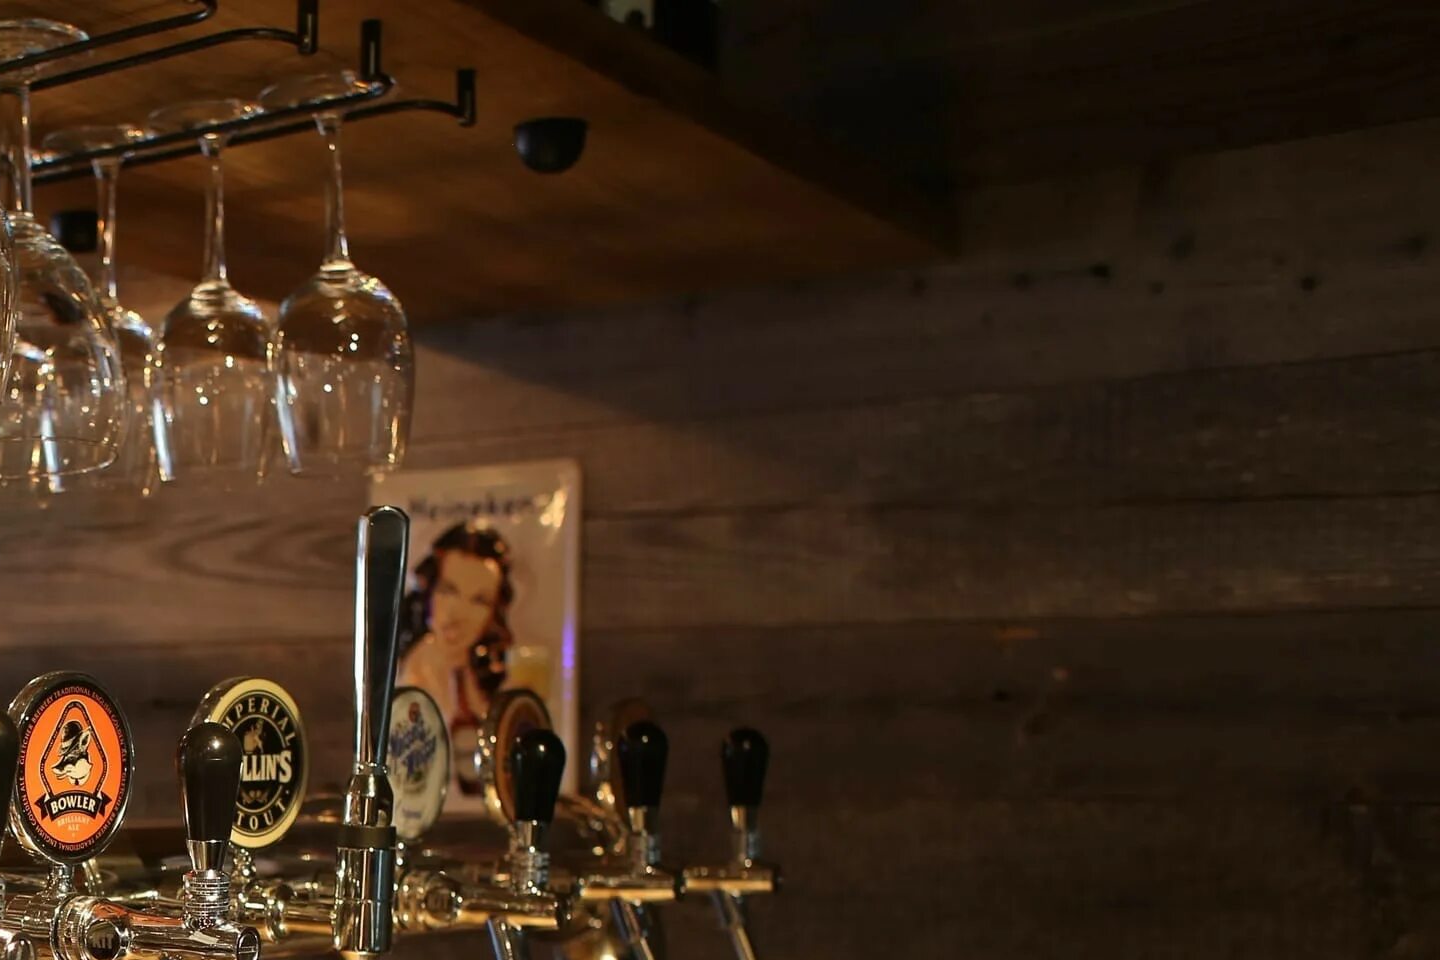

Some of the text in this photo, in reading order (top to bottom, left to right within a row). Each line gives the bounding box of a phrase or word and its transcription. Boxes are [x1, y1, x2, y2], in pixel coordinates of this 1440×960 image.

[30, 692, 54, 724] BREWERY
[53, 686, 91, 698] TRADITIONAL
[222, 697, 296, 747] MPERIAL
[241, 750, 292, 784] LLIN'S
[21, 792, 37, 827] GOLDEN
[50, 794, 96, 814] BOWLER
[236, 803, 286, 831] TOUT
[35, 823, 57, 848] ENGLISH
